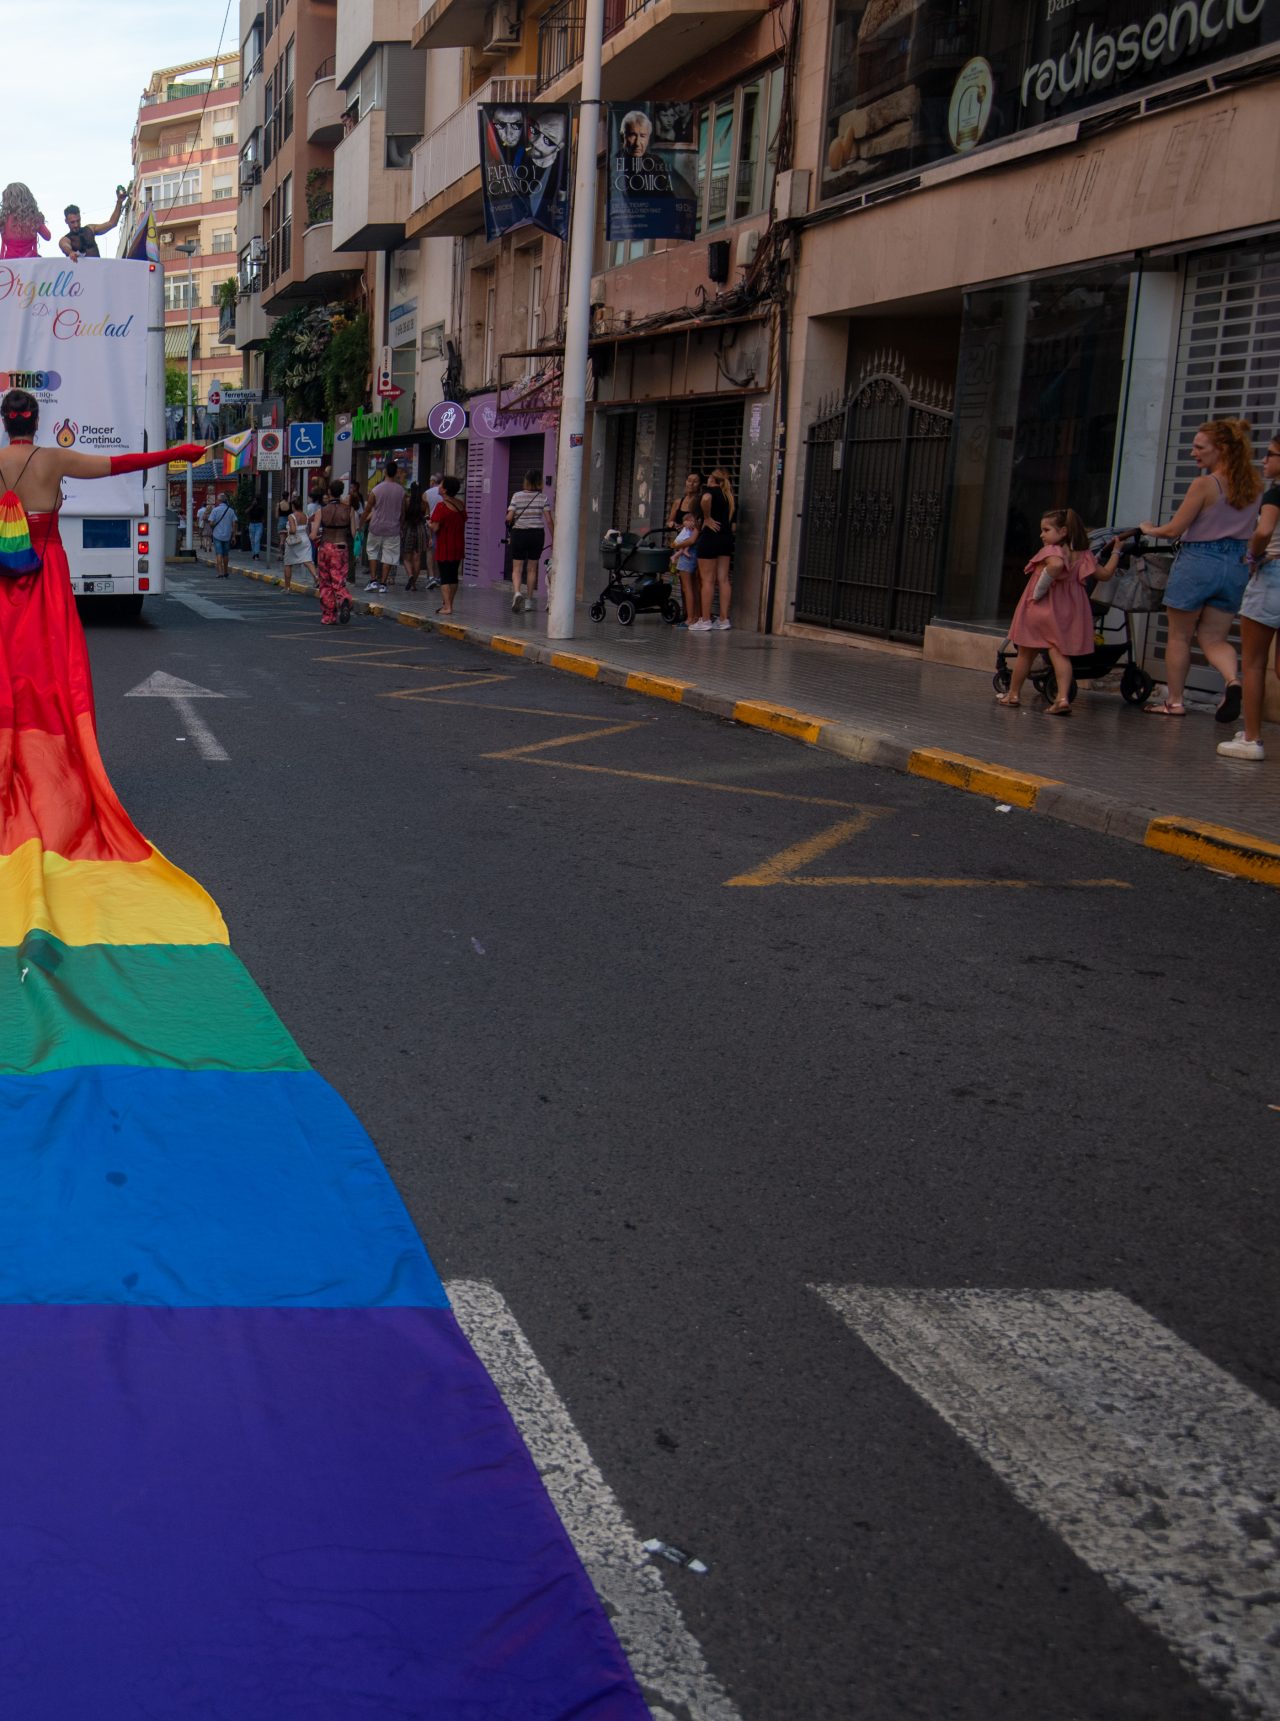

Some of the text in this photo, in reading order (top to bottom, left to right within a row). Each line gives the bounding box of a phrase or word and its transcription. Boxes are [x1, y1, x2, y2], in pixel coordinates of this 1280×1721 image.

[616, 157, 629, 172] EL
[52, 309, 134, 341] Ciudad
[8, 373, 45, 389] TEMIS
[81, 425, 114, 435] Placer
[79, 435, 121, 444] Continuo
